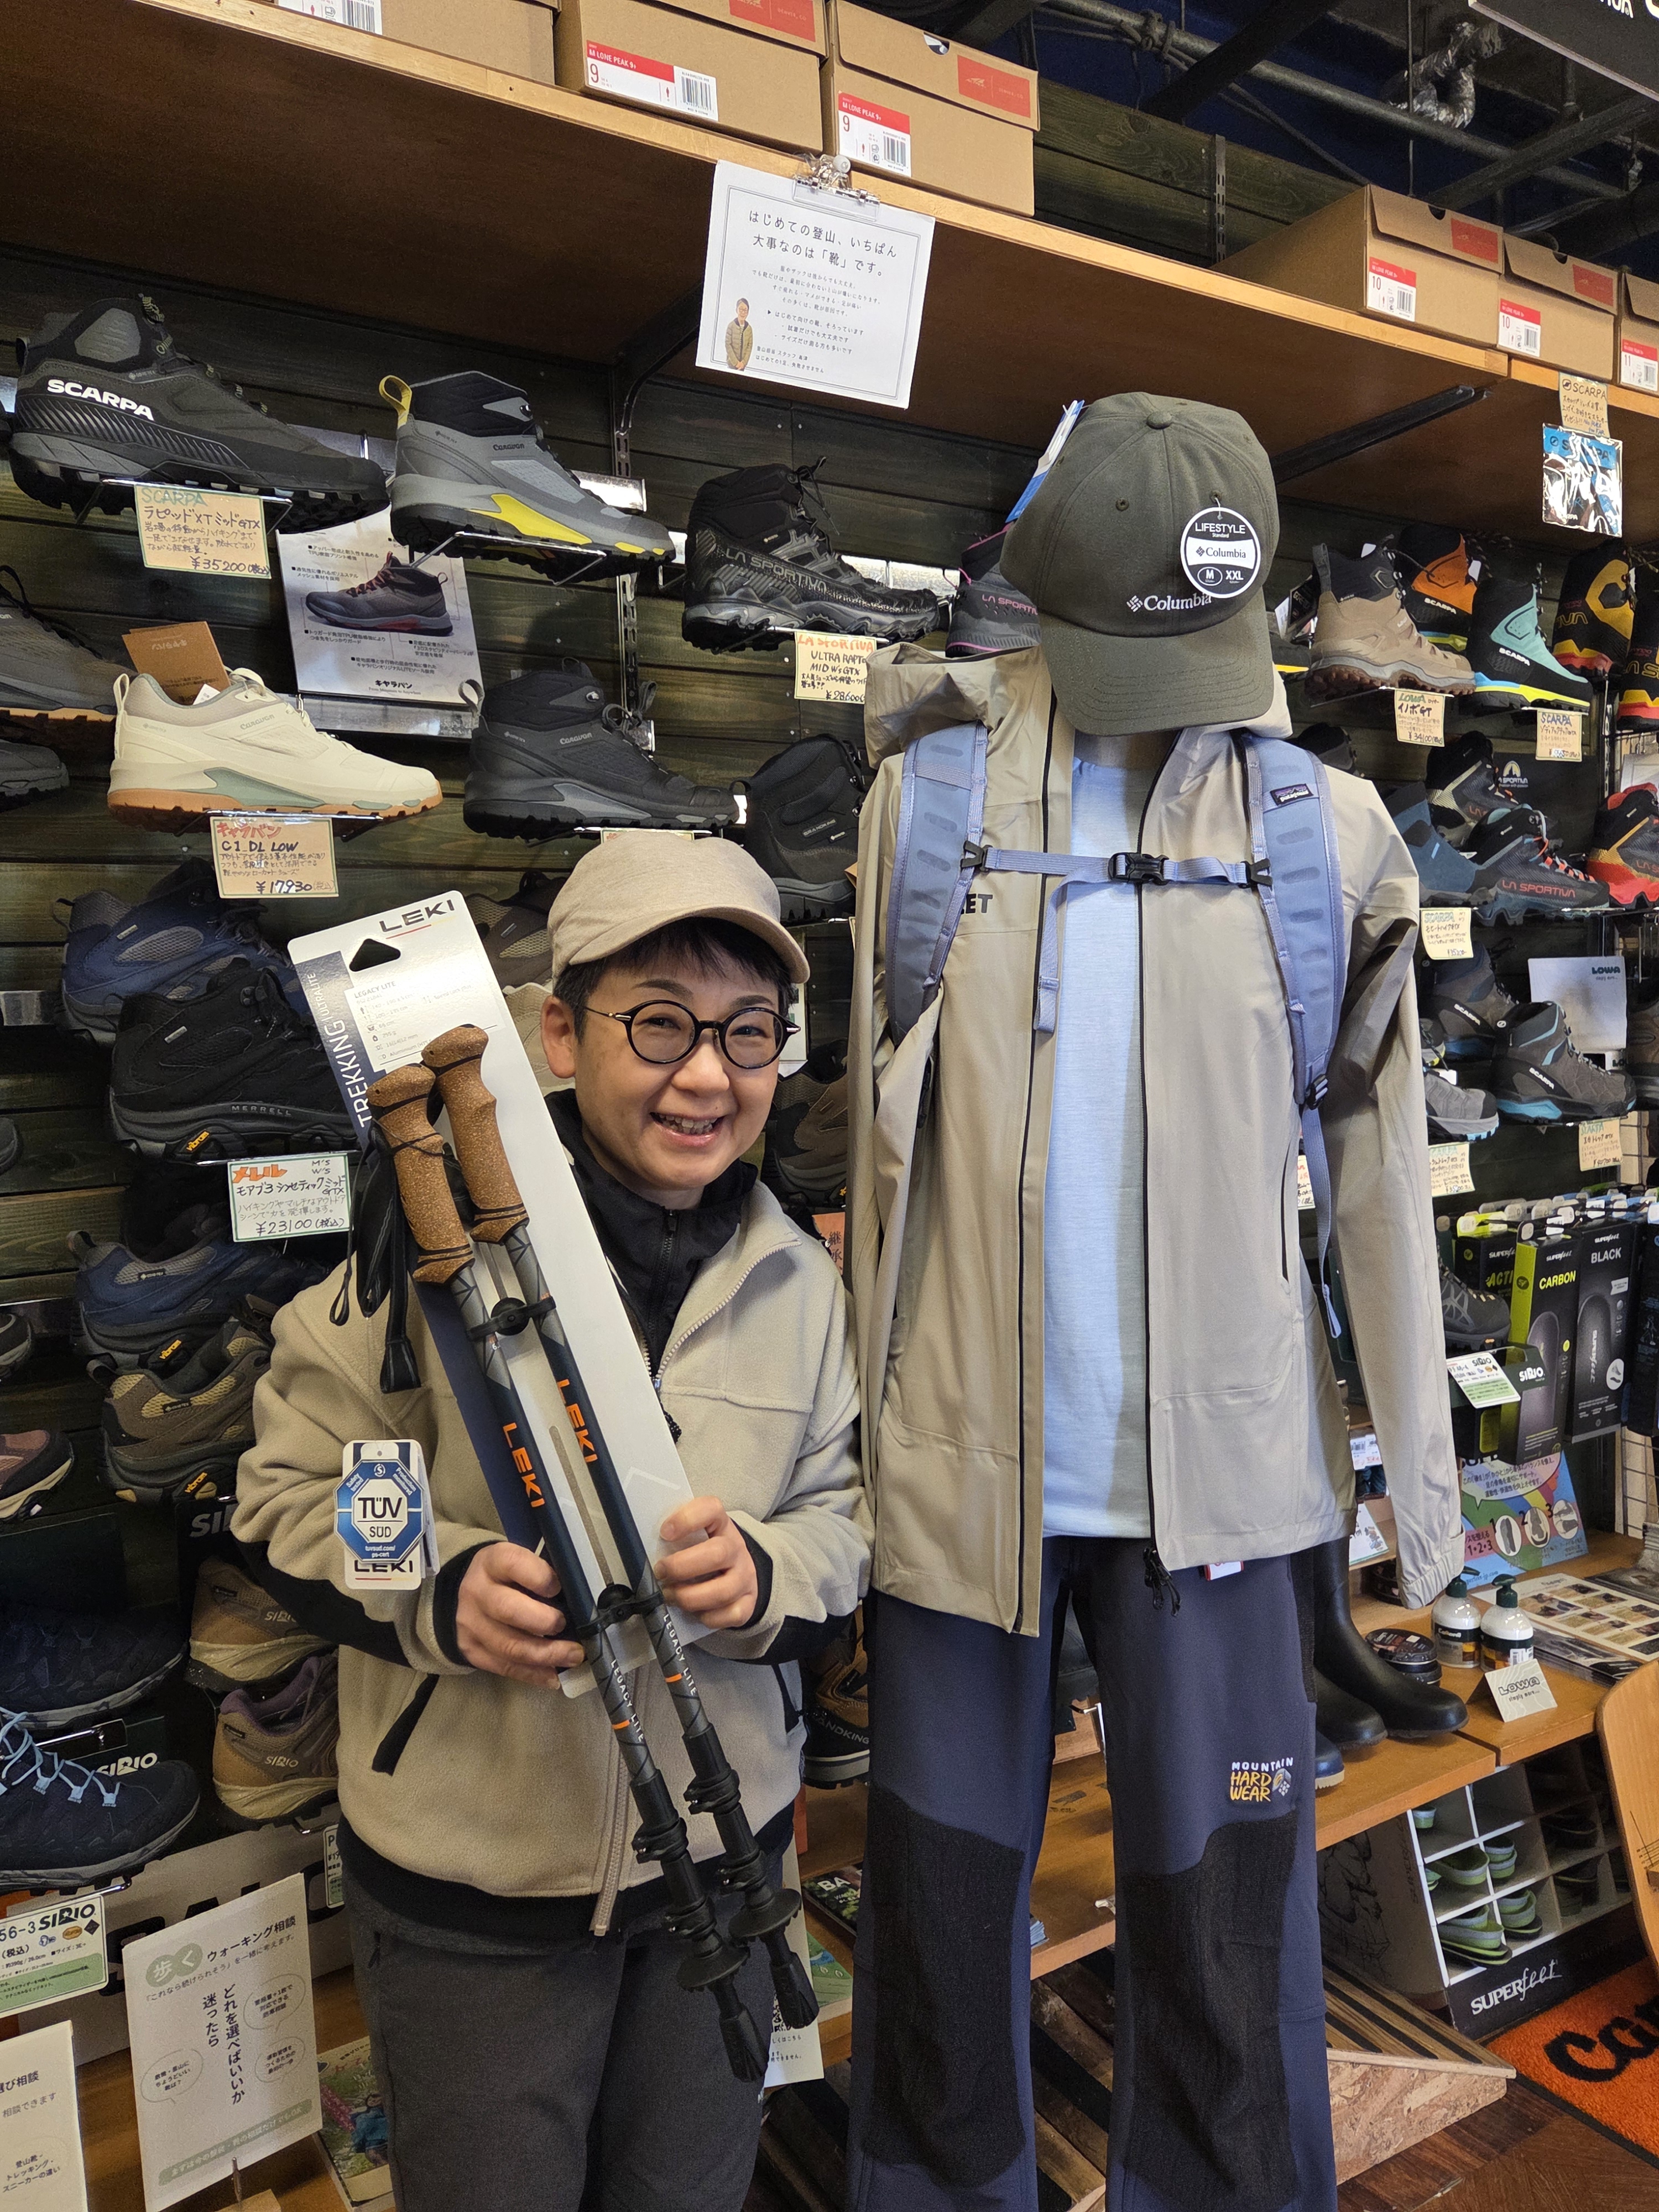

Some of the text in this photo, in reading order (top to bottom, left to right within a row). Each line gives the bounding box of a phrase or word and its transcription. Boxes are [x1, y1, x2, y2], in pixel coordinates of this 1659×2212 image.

[613, 56, 629, 67] PEAK
[590, 63, 599, 83] 9
[843, 114, 850, 132] 9
[753, 233, 883, 276] 大事なのは「靴」です。
[1373, 275, 1381, 290] 10
[1503, 315, 1510, 329] 10
[1624, 354, 1631, 367] 11
[47, 378, 154, 421] SCARPA
[1573, 382, 1608, 402] SCARPA
[492, 443, 525, 451] Caravan
[141, 487, 208, 507] SCARPA
[1194, 522, 1246, 534] LIFESTYLE
[1206, 547, 1246, 559] Columbia
[726, 548, 827, 595] LA SPORTIVA
[1206, 569, 1244, 581] M XXL
[982, 594, 995, 603] LA
[1144, 592, 1212, 611] Columbia
[1424, 597, 1457, 614] SCARPA
[797, 634, 814, 646] LA
[811, 650, 868, 665] ULTRA RAPTO
[1499, 647, 1531, 666] SCARPA
[810, 662, 830, 672] MID
[843, 666, 861, 676] GTX
[374, 680, 413, 689] キャラバン
[1398, 692, 1426, 703] LOWA
[239, 714, 275, 731] Caravan
[1541, 712, 1573, 727] SCARPA
[560, 733, 593, 745] Caravan
[216, 822, 282, 839] キャラバン
[270, 841, 299, 852] LOW
[1502, 879, 1576, 899] LA SPORTIVA
[379, 899, 455, 933] LEKI
[1592, 966, 1621, 975] LOWA
[353, 980, 397, 999] LEGACY LITE
[307, 972, 373, 1129] ULTRALITE TREKKING
[1528, 1067, 1555, 1090] SCARPA
[231, 1105, 293, 1117] MERRELL
[186, 1131, 210, 1151] vibram
[232, 1164, 288, 1184] メレル
[321, 1187, 345, 1196] GTX
[1590, 1246, 1622, 1264] BLACK
[1487, 1270, 1514, 1288] ACTI
[1538, 1270, 1577, 1291] CARBON
[159, 1339, 182, 1359] vibram
[1472, 1357, 1492, 1367] SIRIO
[1519, 1366, 1544, 1382] SIRIO
[557, 1379, 598, 1463] LEKI
[502, 1422, 545, 1508] LEKI
[184, 1472, 208, 1493] vibram
[357, 1497, 403, 1519] TÜV
[1545, 1503, 1554, 1519] 3
[1489, 1517, 1497, 1533] 1
[1519, 1510, 1528, 1526] 2
[369, 1526, 392, 1538] SÜD
[354, 1560, 414, 1573] LEKI
[1498, 1676, 1541, 1696] LOWA
[96, 1752, 159, 1777] SIRIO
[264, 1755, 299, 1768] SIRIO
[1232, 1757, 1294, 1771] MOUNTAIN
[1230, 1771, 1272, 1787] HARD
[1230, 1786, 1271, 1802] WEAR
[38, 1903, 96, 1931] SIRIO
[207, 1915, 296, 1963] ウォーキング相談
[2, 1944, 30, 1959] (税込)
[153, 1949, 194, 1983] 歩く
[1470, 1958, 1562, 2016] SUPERfeet
[202, 1991, 220, 2048] 迷ったら
[222, 1983, 245, 2106] どれを選べばいいか
[2, 2092, 57, 2118] 相談できます
